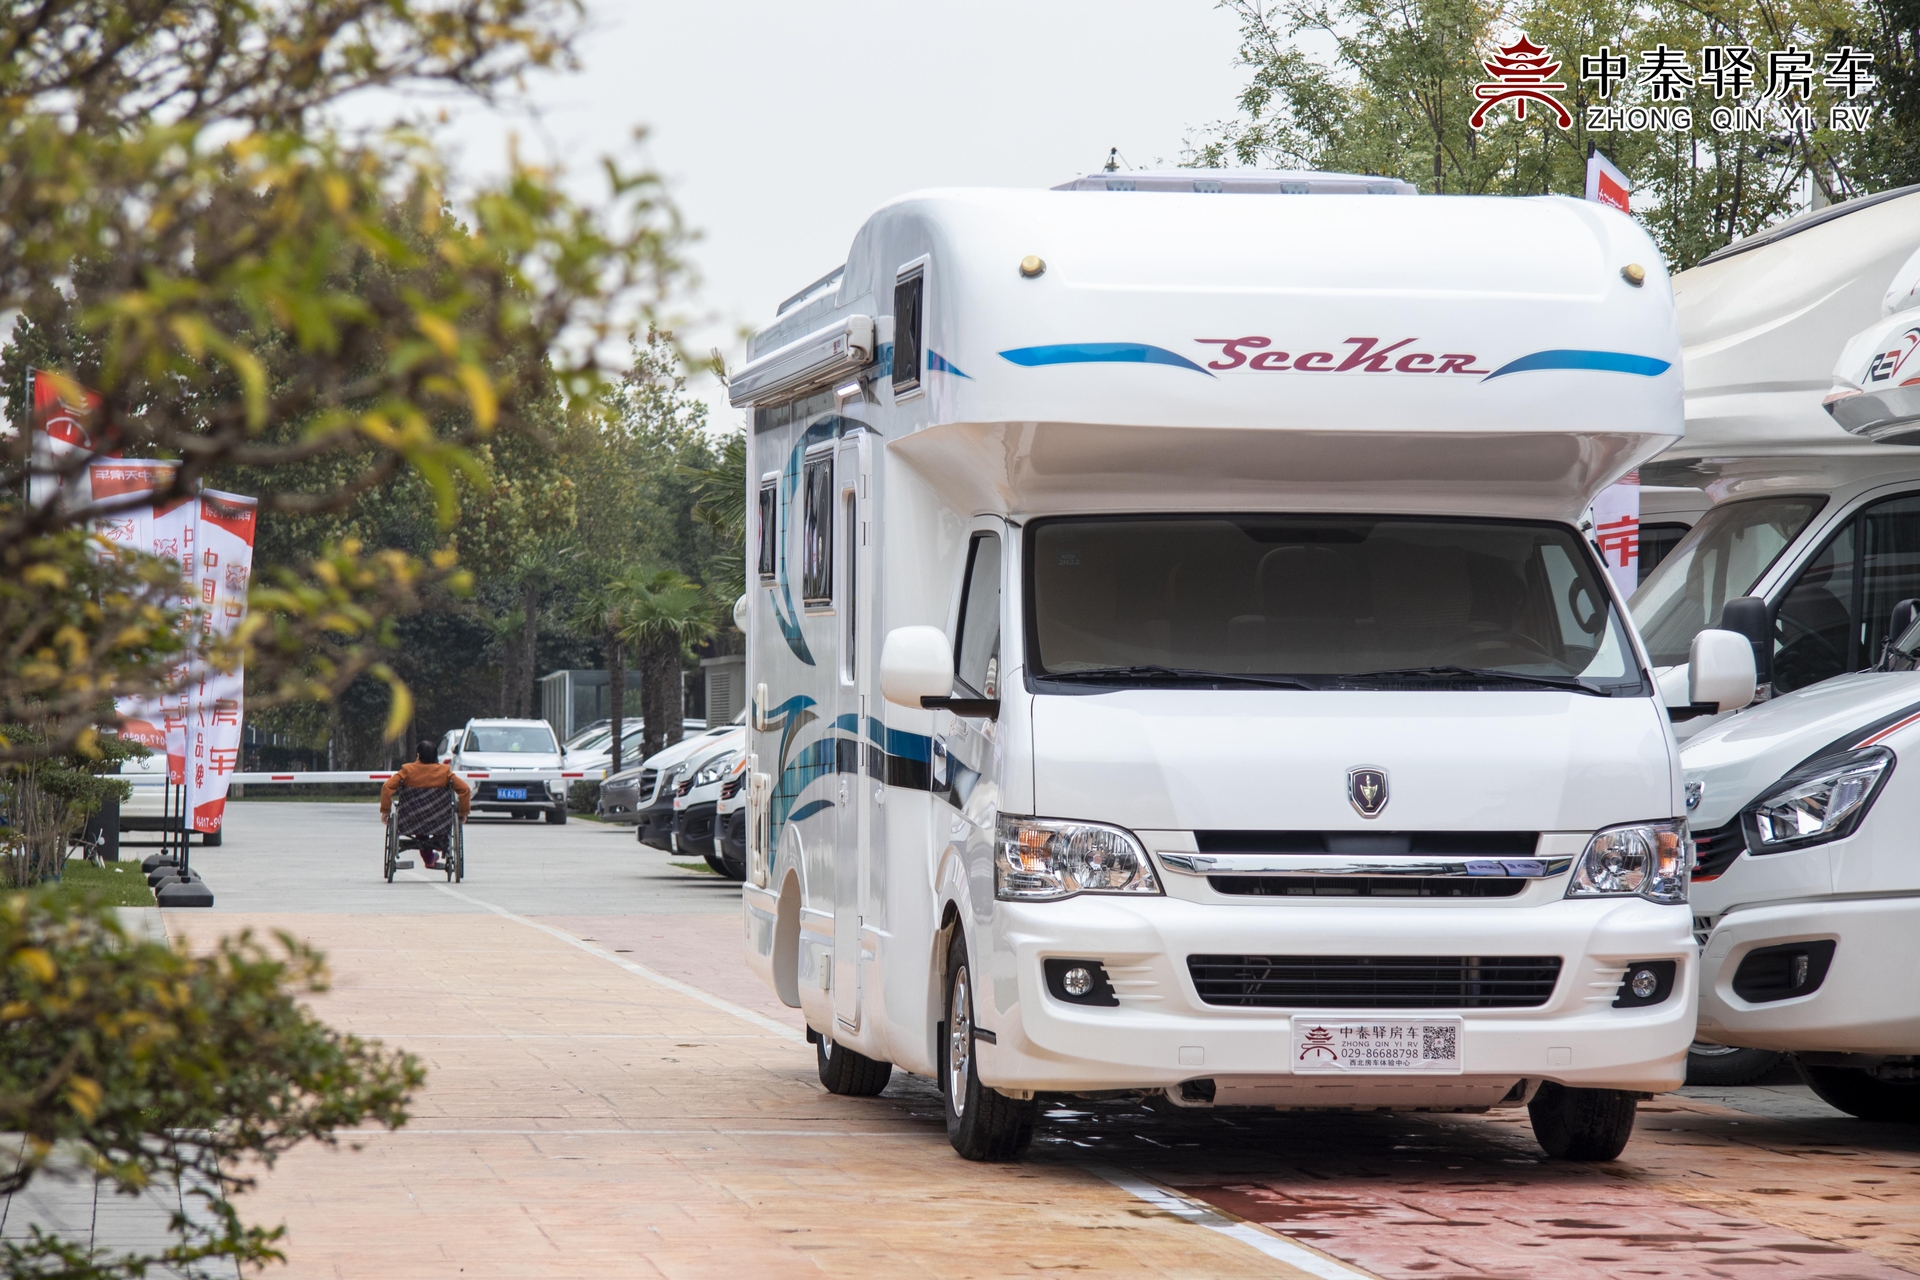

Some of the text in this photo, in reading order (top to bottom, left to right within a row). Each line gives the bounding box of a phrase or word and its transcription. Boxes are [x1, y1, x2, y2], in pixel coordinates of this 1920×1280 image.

[1058, 558, 1081, 566] 2022
[1340, 1026, 1420, 1039] 中秦驿房车
[1341, 1049, 1419, 1058] 029-86688798
